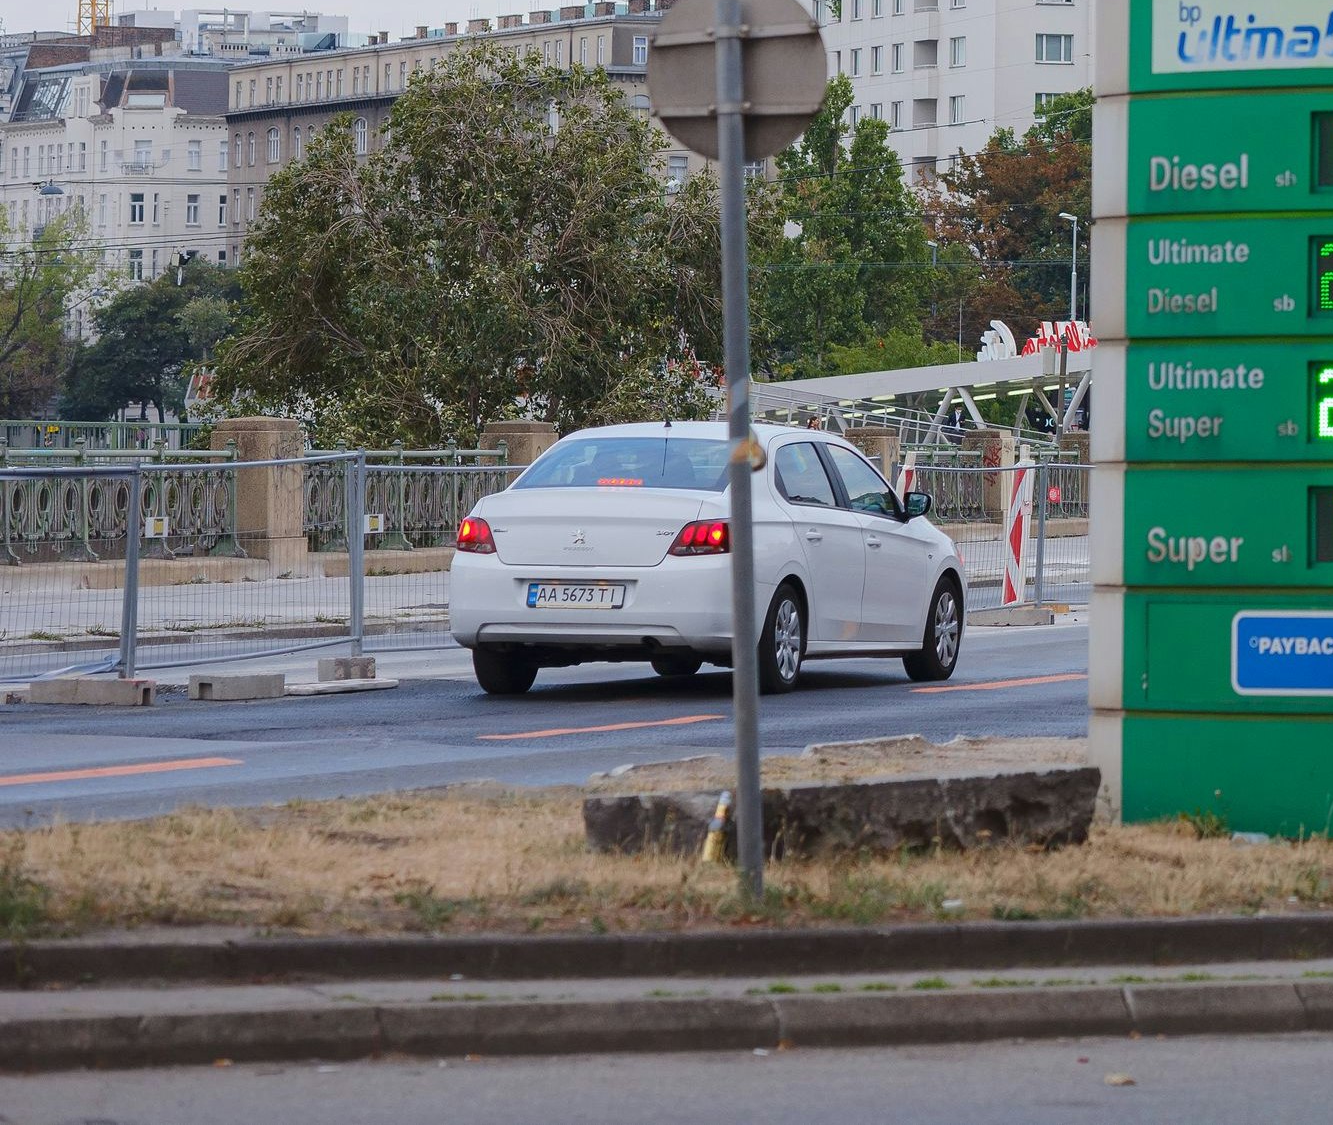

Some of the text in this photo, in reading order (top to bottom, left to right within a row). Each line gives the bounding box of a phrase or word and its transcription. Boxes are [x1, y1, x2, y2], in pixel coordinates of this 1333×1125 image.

[1178, 0, 1200, 27] bp
[1149, 153, 1249, 192] Diesel
[1148, 238, 1250, 265] Ultimate
[1148, 287, 1217, 314] Diesel
[1148, 362, 1264, 390] Ultimate
[1148, 408, 1223, 443] Super
[1147, 527, 1243, 571] Super
[537, 588, 557, 602] AA
[562, 588, 594, 602] 5673
